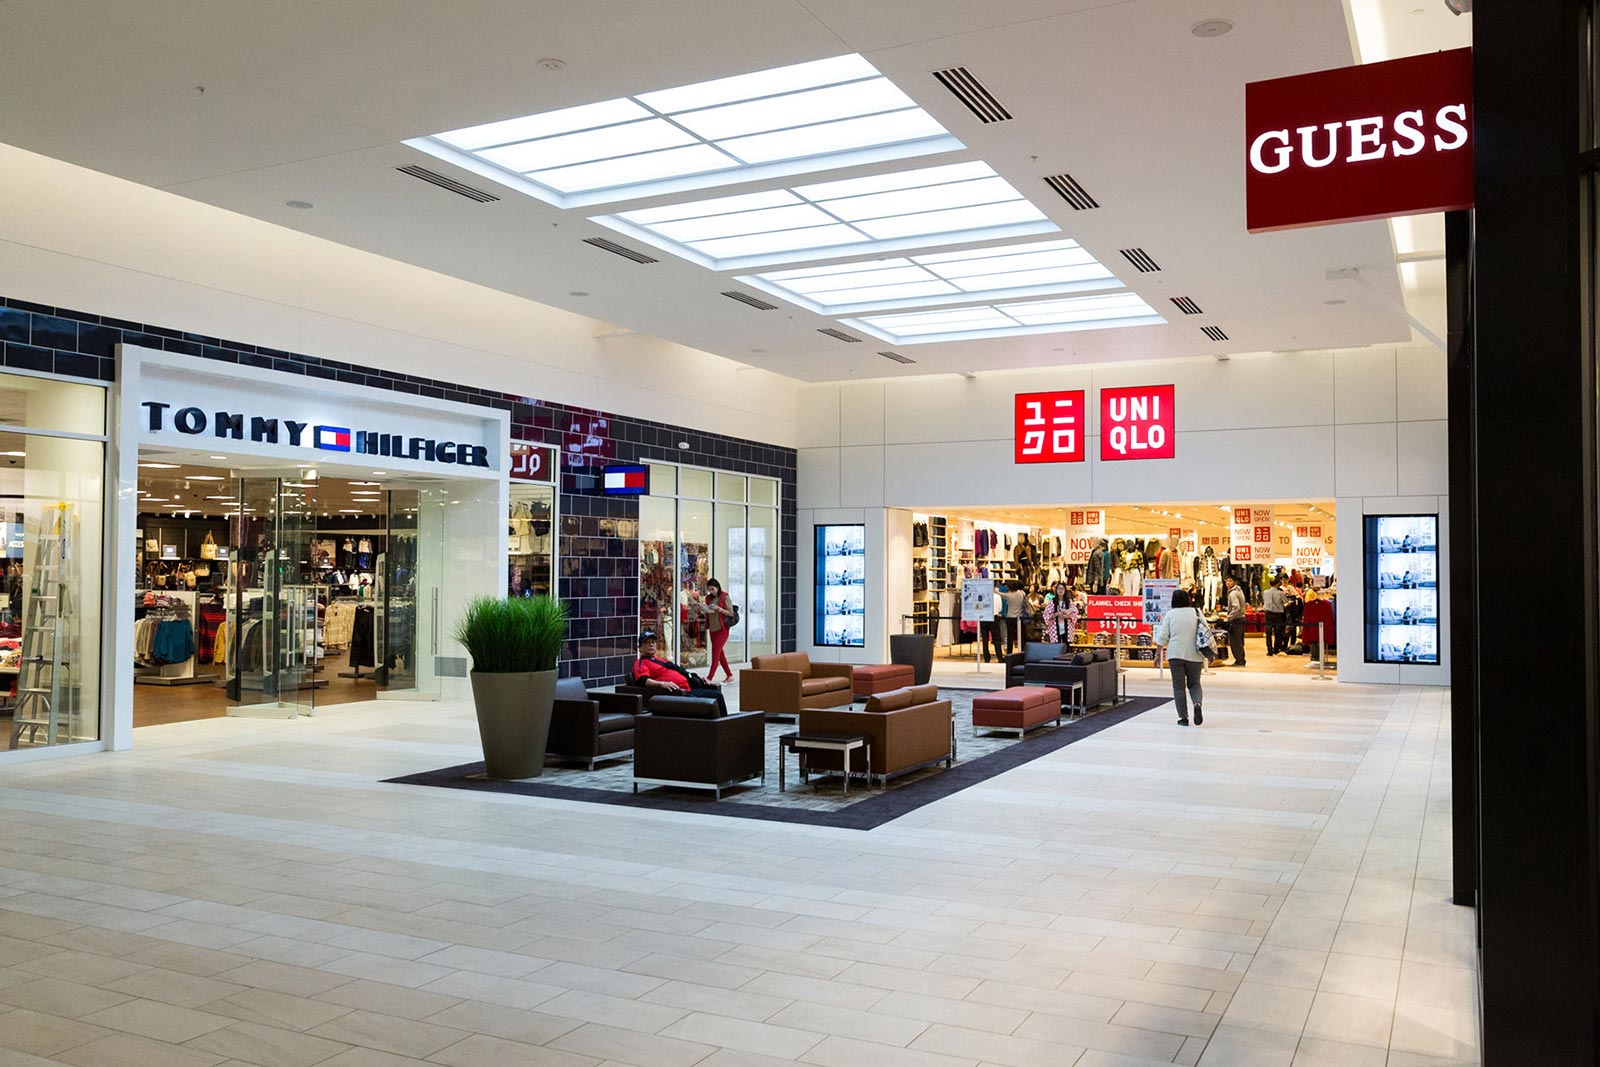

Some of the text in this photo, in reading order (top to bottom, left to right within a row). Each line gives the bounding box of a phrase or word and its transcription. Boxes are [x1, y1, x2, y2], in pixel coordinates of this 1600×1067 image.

[1250, 103, 1468, 174] GUESS
[1109, 395, 1160, 422] UNI
[141, 401, 490, 468] TOMMY HILFIGER
[1109, 424, 1166, 455] QLO
[1279, 536, 1290, 545] TO
[1296, 547, 1321, 557] NOW
